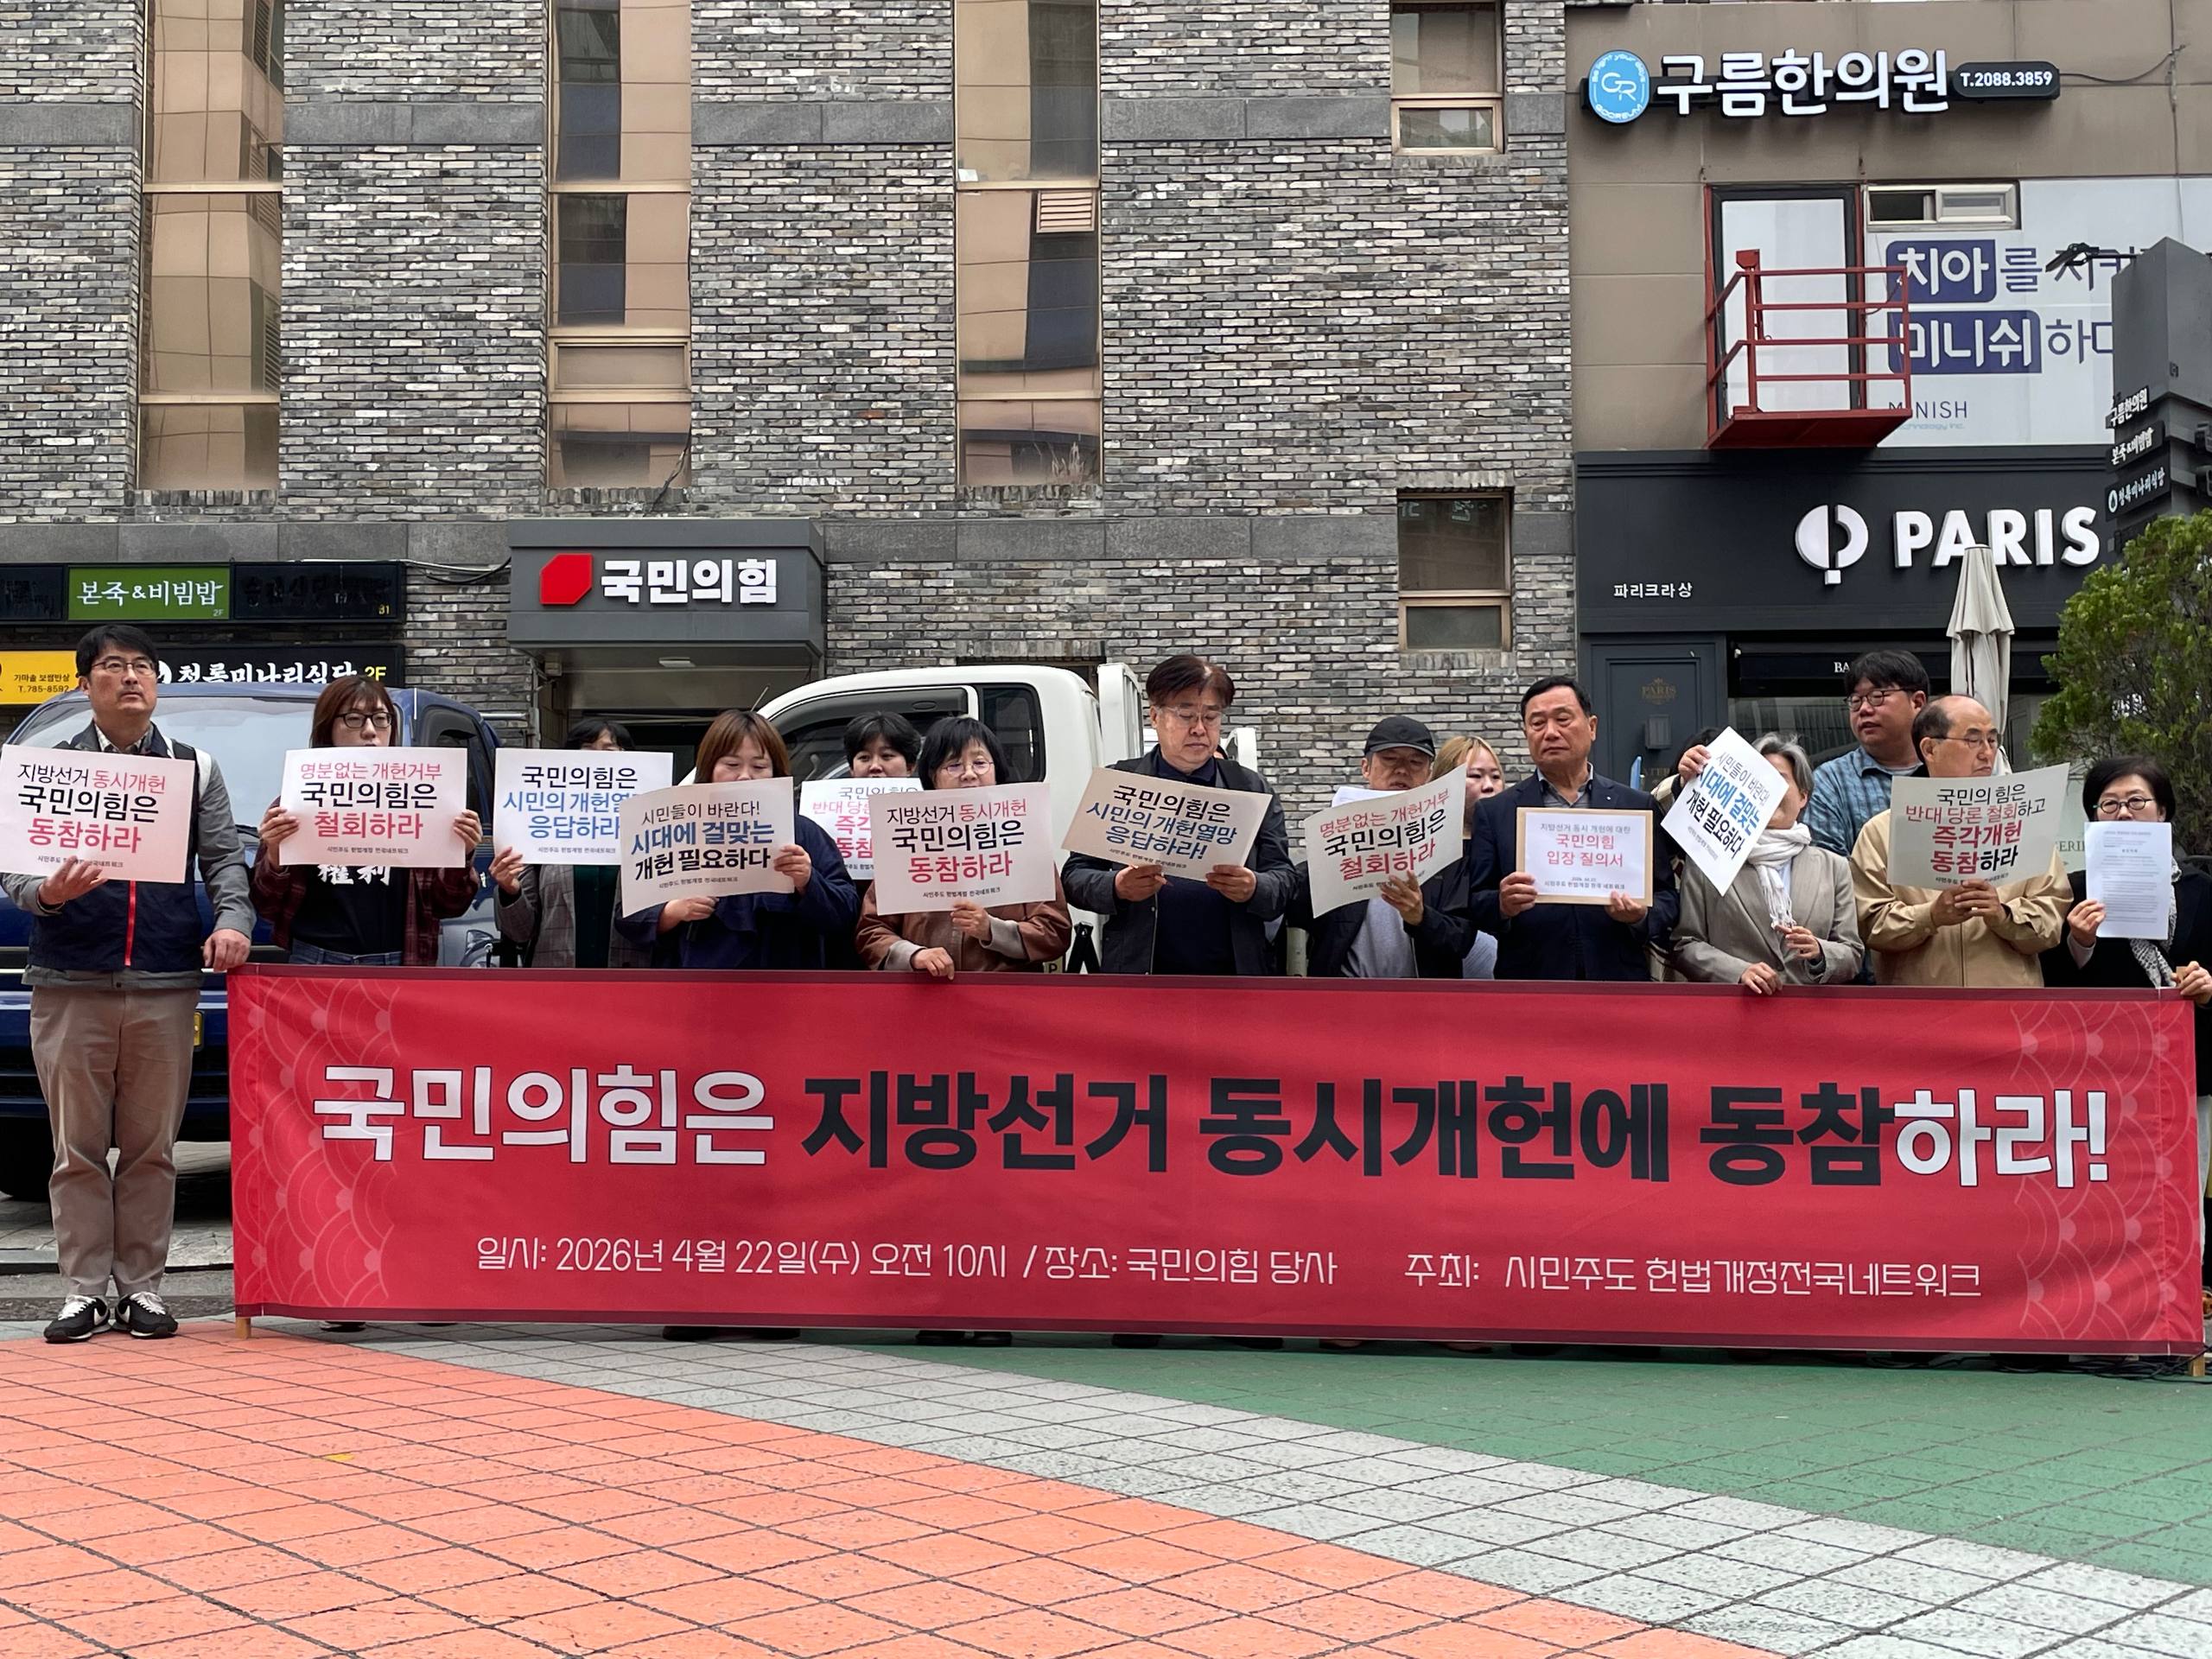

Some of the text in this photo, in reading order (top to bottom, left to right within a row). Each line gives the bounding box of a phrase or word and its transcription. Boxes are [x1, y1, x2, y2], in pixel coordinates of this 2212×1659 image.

[1657, 48, 1948, 116] 구름한의원
[1961, 70, 2053, 87] T.2088.3859
[1897, 247, 2043, 295] 치아를
[1889, 401, 1967, 418] NISH
[2111, 388, 2148, 427] 구름한의원
[1894, 506, 2100, 568] PARIS
[601, 558, 778, 603] 국민의힘
[1613, 582, 1693, 599] 파리크라상
[17, 764, 166, 794] 지방선거 동시개헌
[301, 762, 442, 780] 명분없는 개헌거부
[521, 766, 638, 789] 국민의힘은
[1717, 752, 1751, 786] 시민들이
[17, 785, 159, 823] 국민의힘은
[300, 781, 437, 809] 국민의힘은
[503, 791, 637, 813] 시민의 개헌열
[812, 801, 842, 815] 반대
[887, 798, 1027, 824] 지방선거 동시개헌
[1113, 785, 1230, 823] 국민의힘은
[1700, 764, 1738, 809] 시대에
[1730, 792, 1759, 836] 걸맞는
[1906, 798, 2045, 824] 반대 당론 철회하고
[1937, 784, 2025, 806] 국민의 힘은
[314, 811, 423, 839] 철회하라
[528, 815, 620, 839] 응답하라
[641, 800, 760, 826] 시민들이 바란다!
[1086, 802, 1237, 845] 시민의 개헌열망
[1320, 789, 1450, 838] 명분없는 개헌거부
[1687, 789, 1709, 822] 개헌
[1703, 807, 1745, 859] 필요하다
[27, 817, 142, 854] 동참하라
[631, 820, 774, 855] 시대에 걸맞는
[892, 820, 1024, 853] 국민의힘은
[1106, 825, 1209, 860] 응답하라!
[1325, 808, 1446, 857] 국민의힘은
[1556, 834, 1614, 849] 국민의힘
[1933, 820, 2022, 849] 즉각개헌
[635, 848, 771, 880] 개헌 필요하다
[908, 850, 1013, 883] 동참하라
[1340, 837, 1435, 881] 철회하라
[1547, 851, 1624, 867] 입장 질의서
[1931, 845, 2018, 874] 동참하라
[313, 1064, 2109, 1188] 국민의힘은 지방선거 동시개헌에 동참하라!
[477, 1236, 547, 1270] 일시:
[556, 1238, 663, 1272] 2026년
[671, 1239, 726, 1273] 4월
[735, 1239, 861, 1275] 22일(수)
[869, 1243, 931, 1277] 오전
[943, 1244, 1006, 1278] 10시
[1126, 1248, 1258, 1283] 국민의힘
[1269, 1250, 1338, 1285] 당사
[1405, 1253, 1480, 1287] 주최:
[1505, 1255, 1637, 1291] 시민주도
